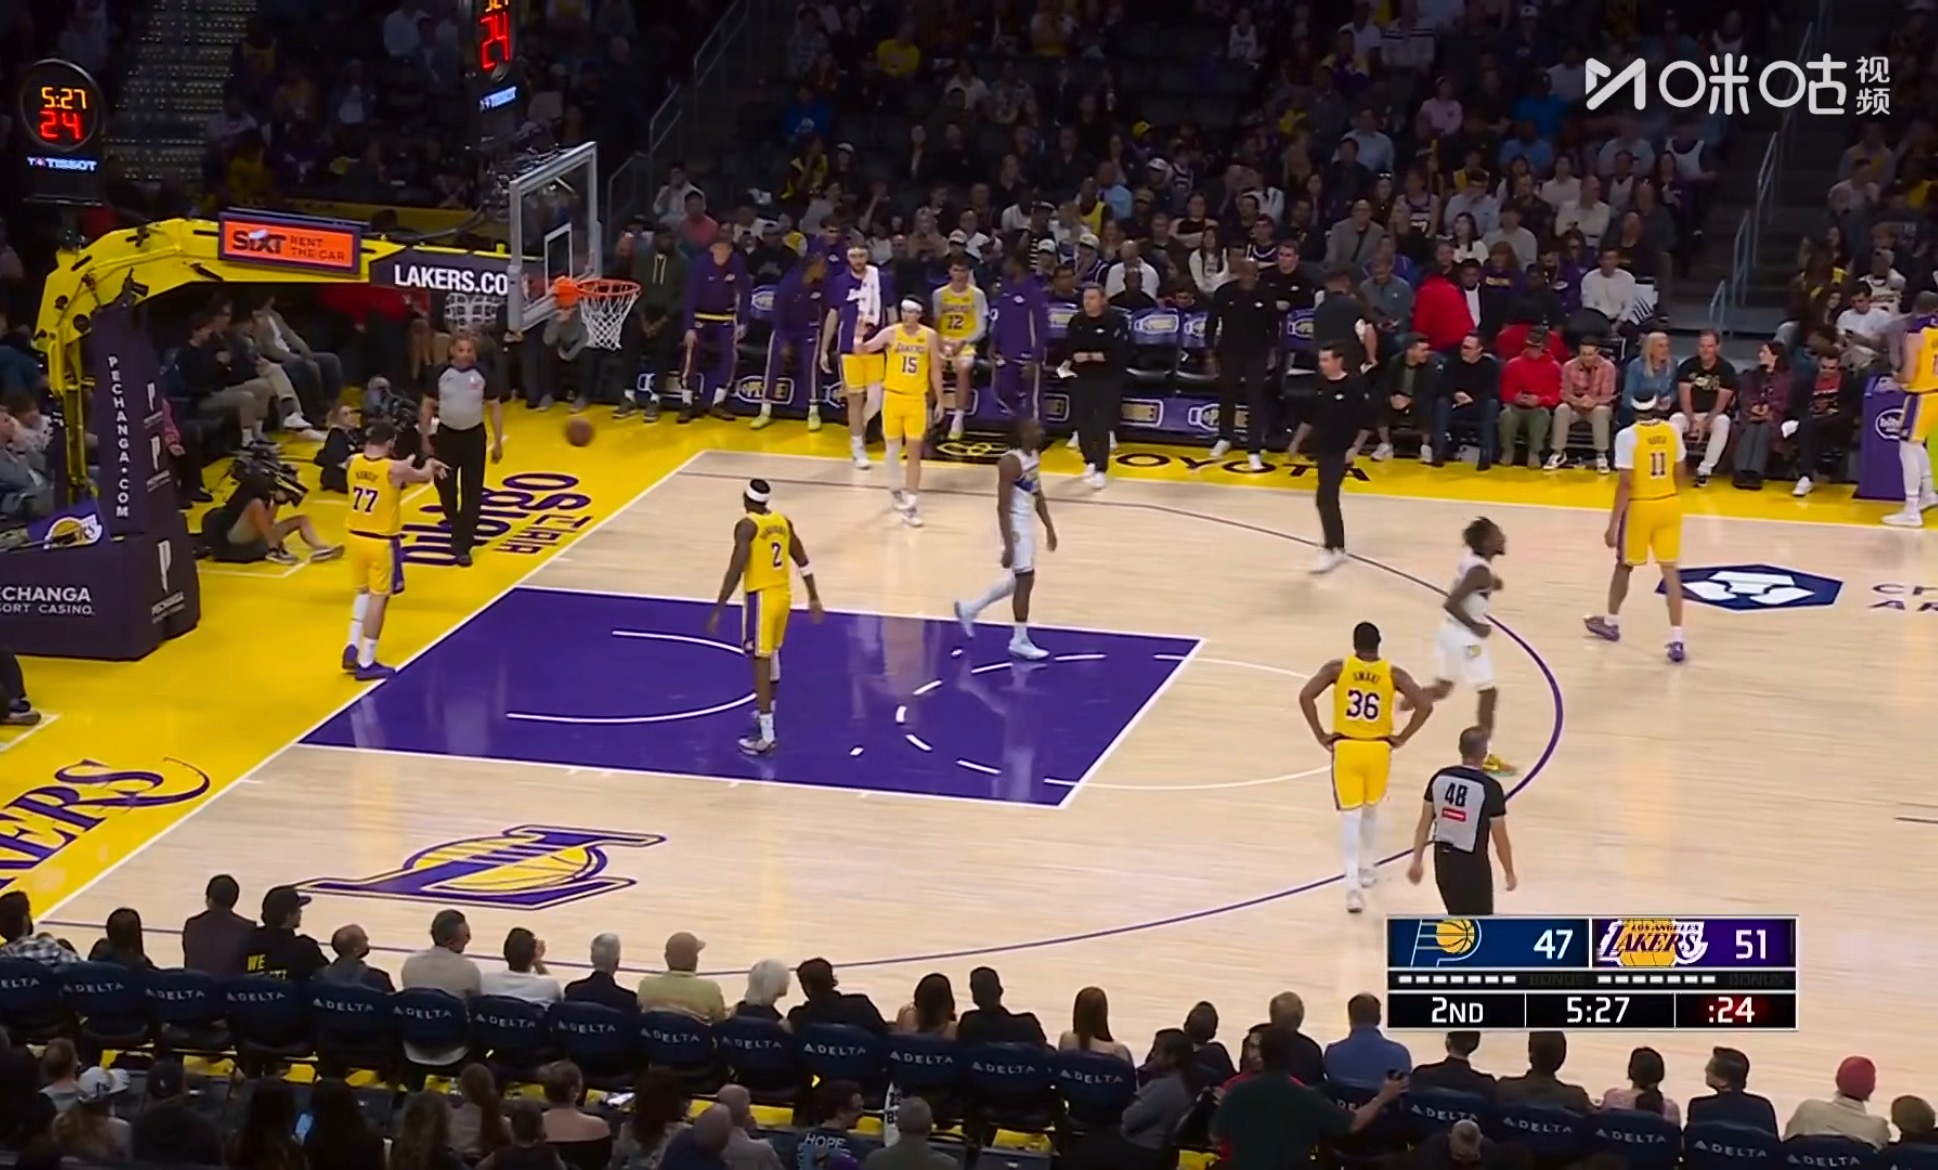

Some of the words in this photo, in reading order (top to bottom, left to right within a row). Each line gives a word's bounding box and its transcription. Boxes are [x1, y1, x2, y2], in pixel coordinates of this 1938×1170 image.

[480, 12, 512, 70] 24
[41, 86, 87, 110] 5:27
[40, 111, 81, 139] 24
[290, 235, 323, 248] RENT
[290, 247, 316, 259] THE
[319, 249, 345, 261] CAR
[394, 264, 508, 296] LAKERS.CO
[902, 355, 918, 375] 15
[1117, 453, 1370, 482] OYOTA
[1649, 450, 1667, 477] 11
[352, 485, 380, 514] 77
[770, 540, 784, 570] 2
[0, 586, 92, 603] CHANGA
[0, 603, 31, 614] ORT
[1345, 688, 1380, 721] 36
[1444, 781, 1469, 807] 48
[247, 953, 266, 971] WE
[75, 982, 125, 993] DELTA
[158, 989, 205, 1000] DELTA
[235, 991, 286, 1001] DELTA
[326, 1001, 375, 1012] DELTA
[406, 1006, 452, 1019] DELTA
[489, 1016, 536, 1028] DELTA
[570, 1023, 617, 1034] DELTA
[653, 1030, 700, 1043] DELTA
[734, 1038, 782, 1049] DELTA
[817, 1043, 866, 1055] DELTA
[904, 1052, 954, 1065] DELTA
[986, 1063, 1035, 1074] DELTA
[1074, 1071, 1123, 1084] DELTA
[1426, 1107, 1478, 1121] DELTA
[1518, 1119, 1571, 1133] DELTA
[1612, 1129, 1666, 1143] DELTA
[1712, 1144, 1767, 1157] DELTA
[1804, 1156, 1860, 1168] DELTA
